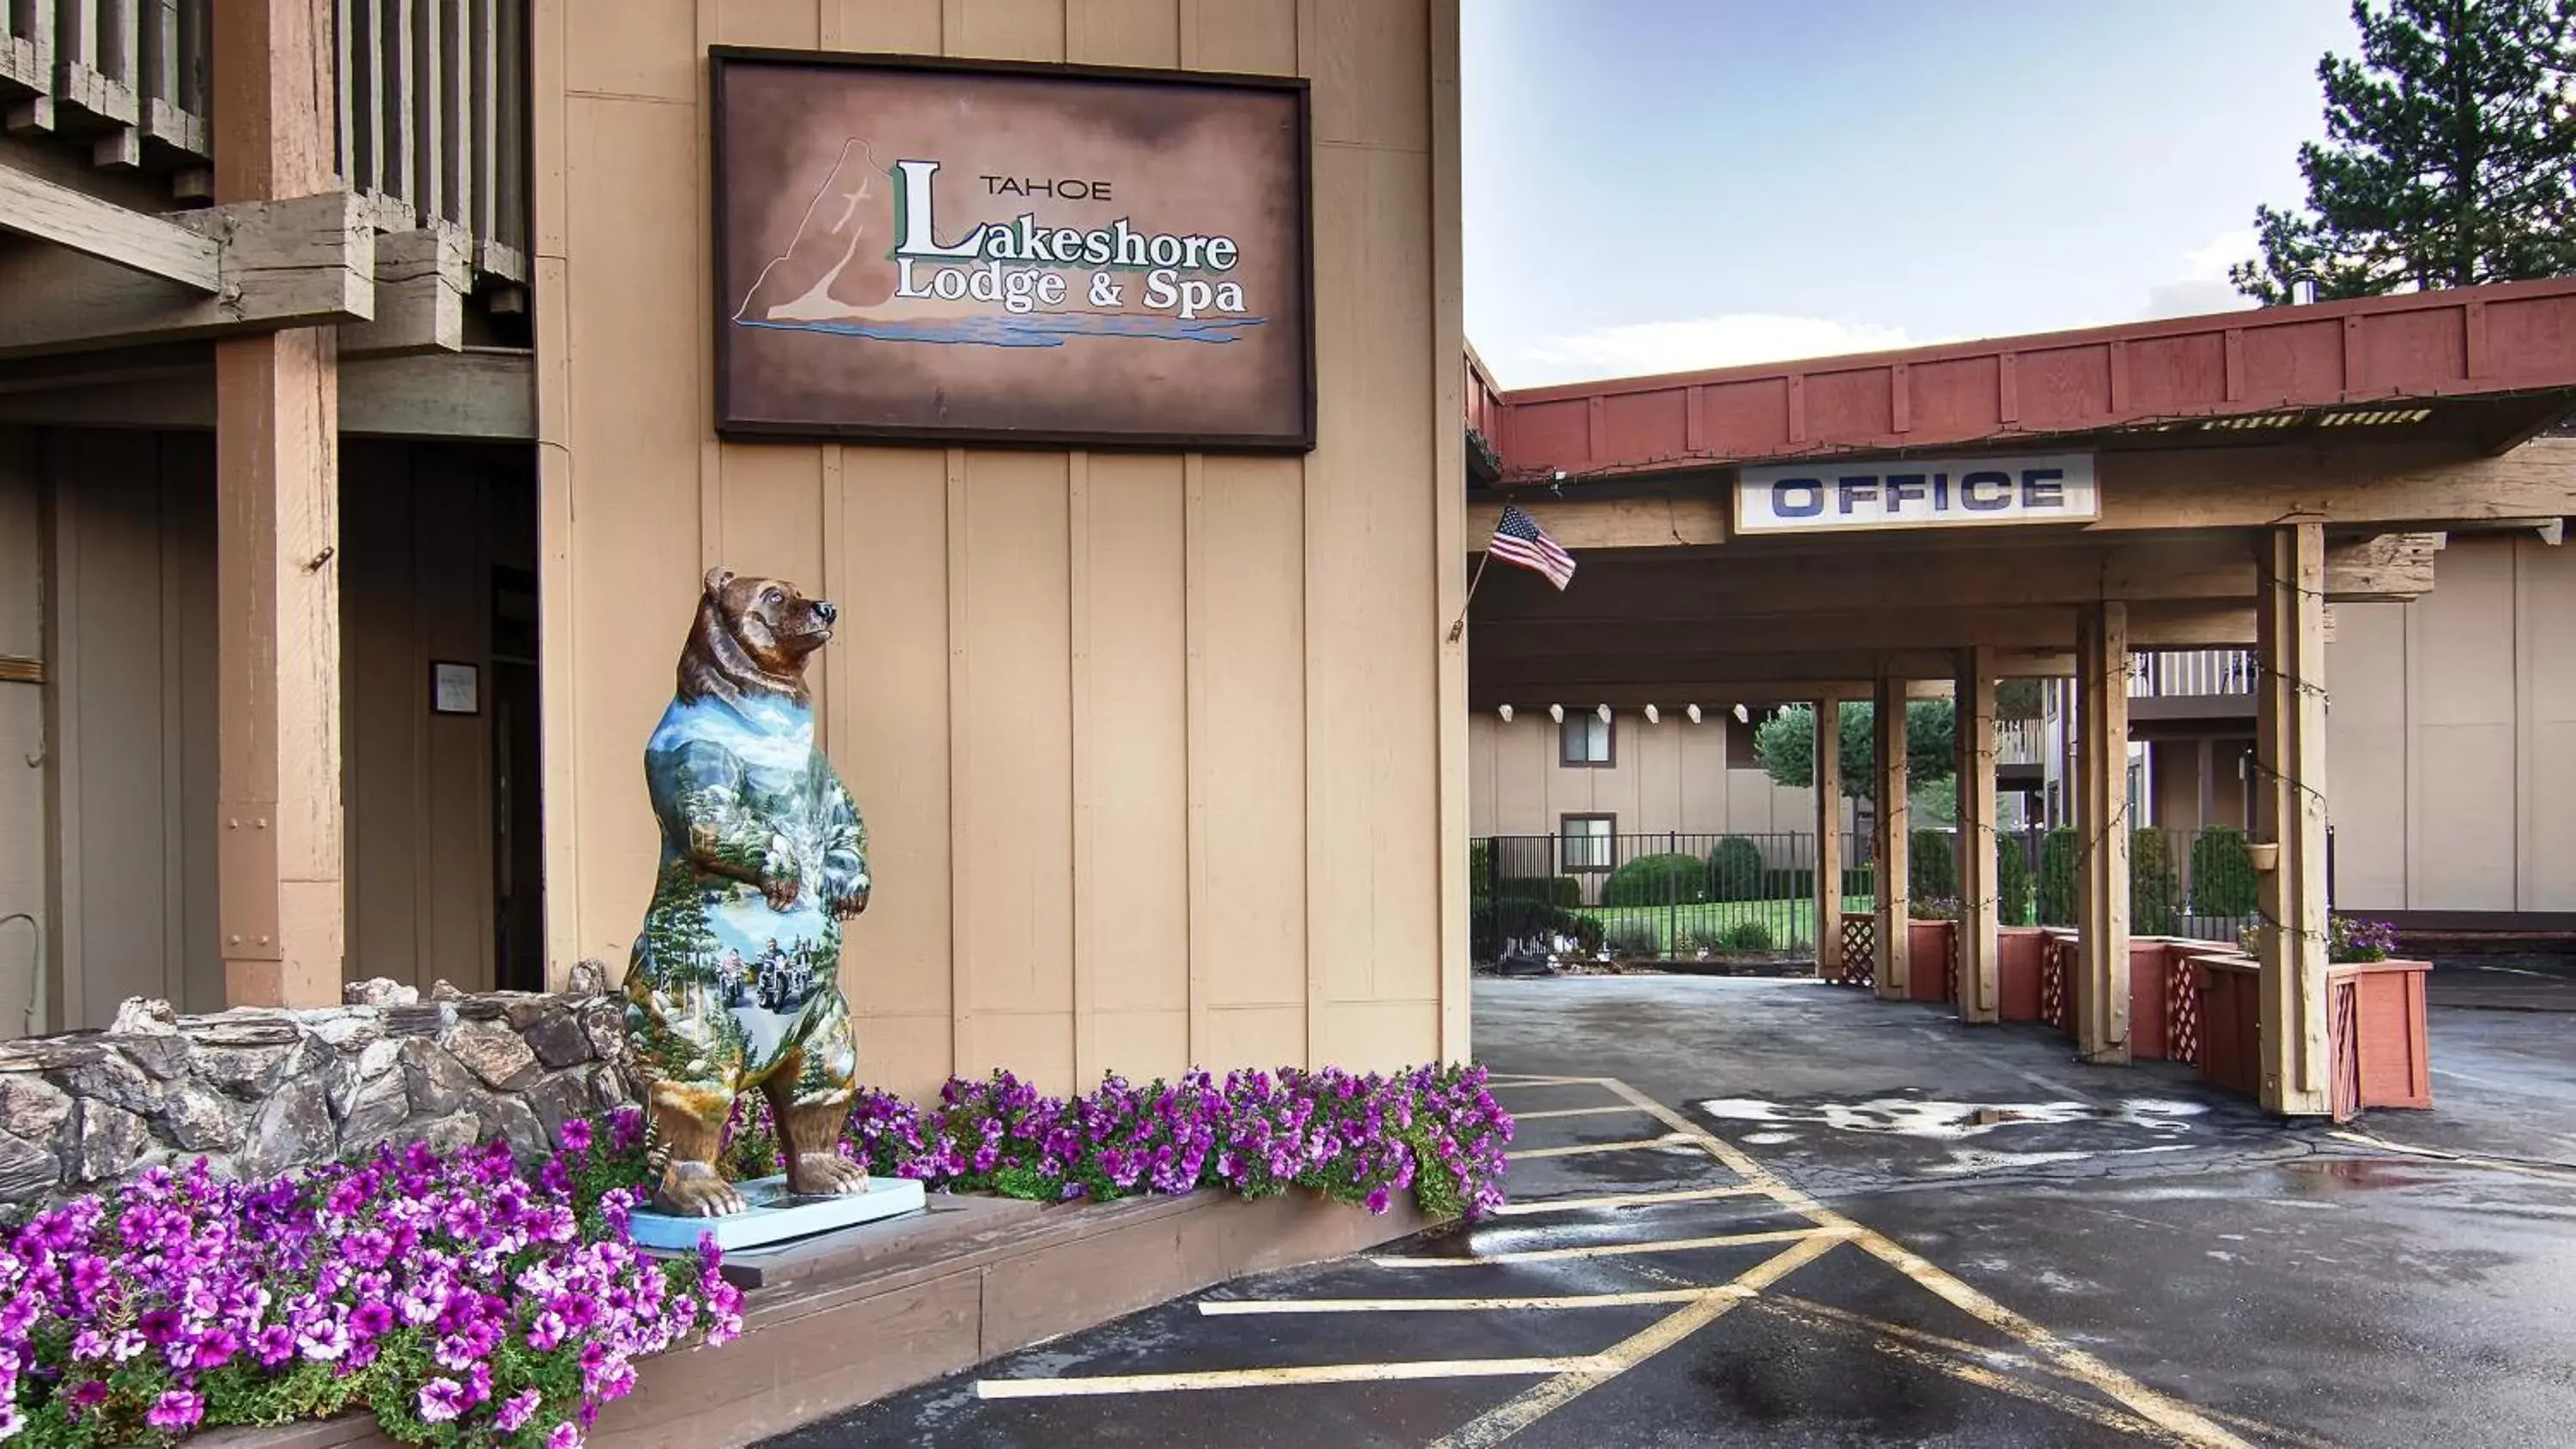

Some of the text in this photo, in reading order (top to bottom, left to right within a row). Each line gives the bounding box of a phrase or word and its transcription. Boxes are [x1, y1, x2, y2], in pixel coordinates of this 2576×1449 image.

[895, 159, 1239, 271] Lakeshore
[980, 175, 1113, 201] TAHOE
[894, 257, 1247, 320] Lodge & Spa
[1771, 468, 2065, 518] OFFICE
